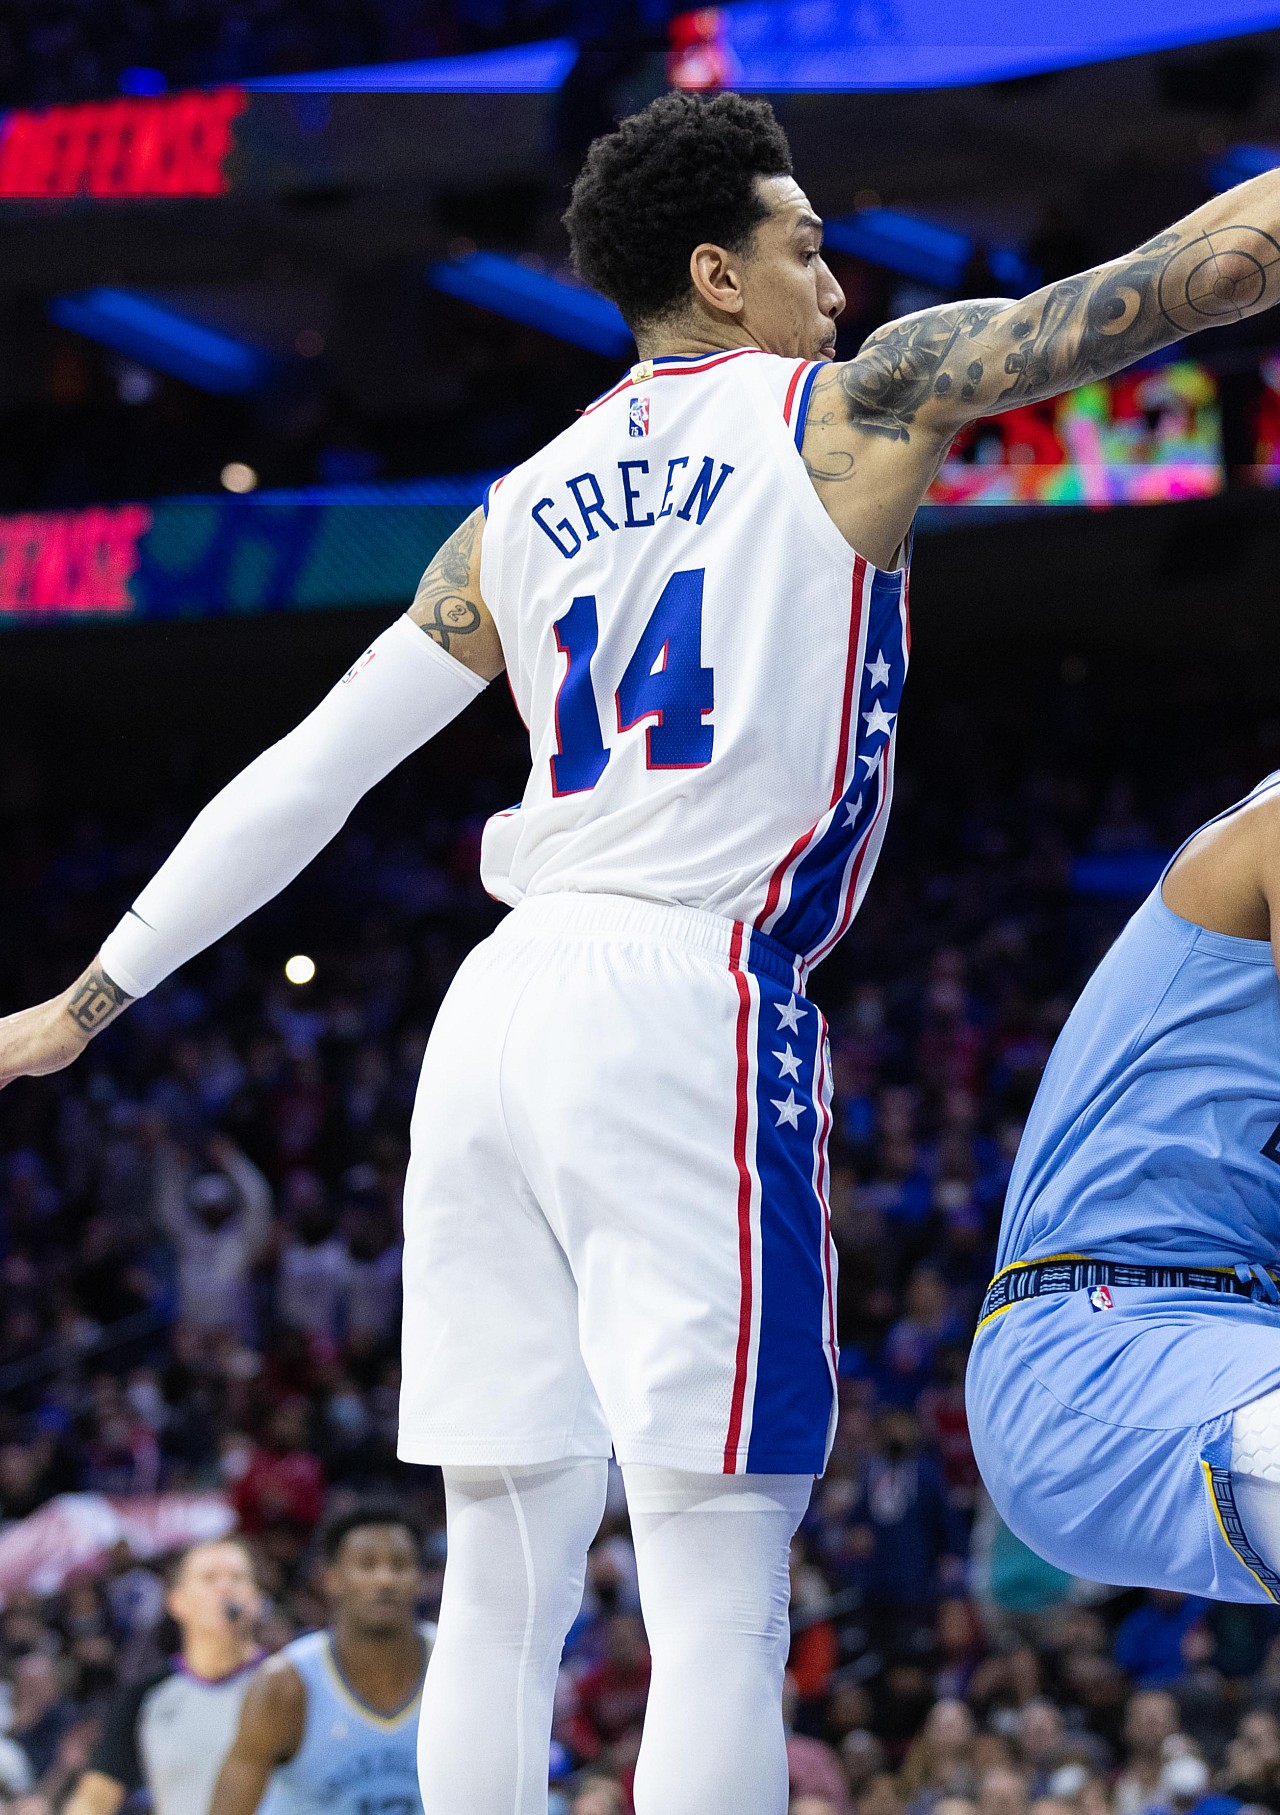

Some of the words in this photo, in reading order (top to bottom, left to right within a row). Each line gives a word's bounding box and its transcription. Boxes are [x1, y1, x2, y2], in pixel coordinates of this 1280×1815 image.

[0, 507, 152, 612] ENSE
[532, 456, 735, 559] GREEN
[447, 604, 467, 622] 2
[549, 567, 715, 798] 14
